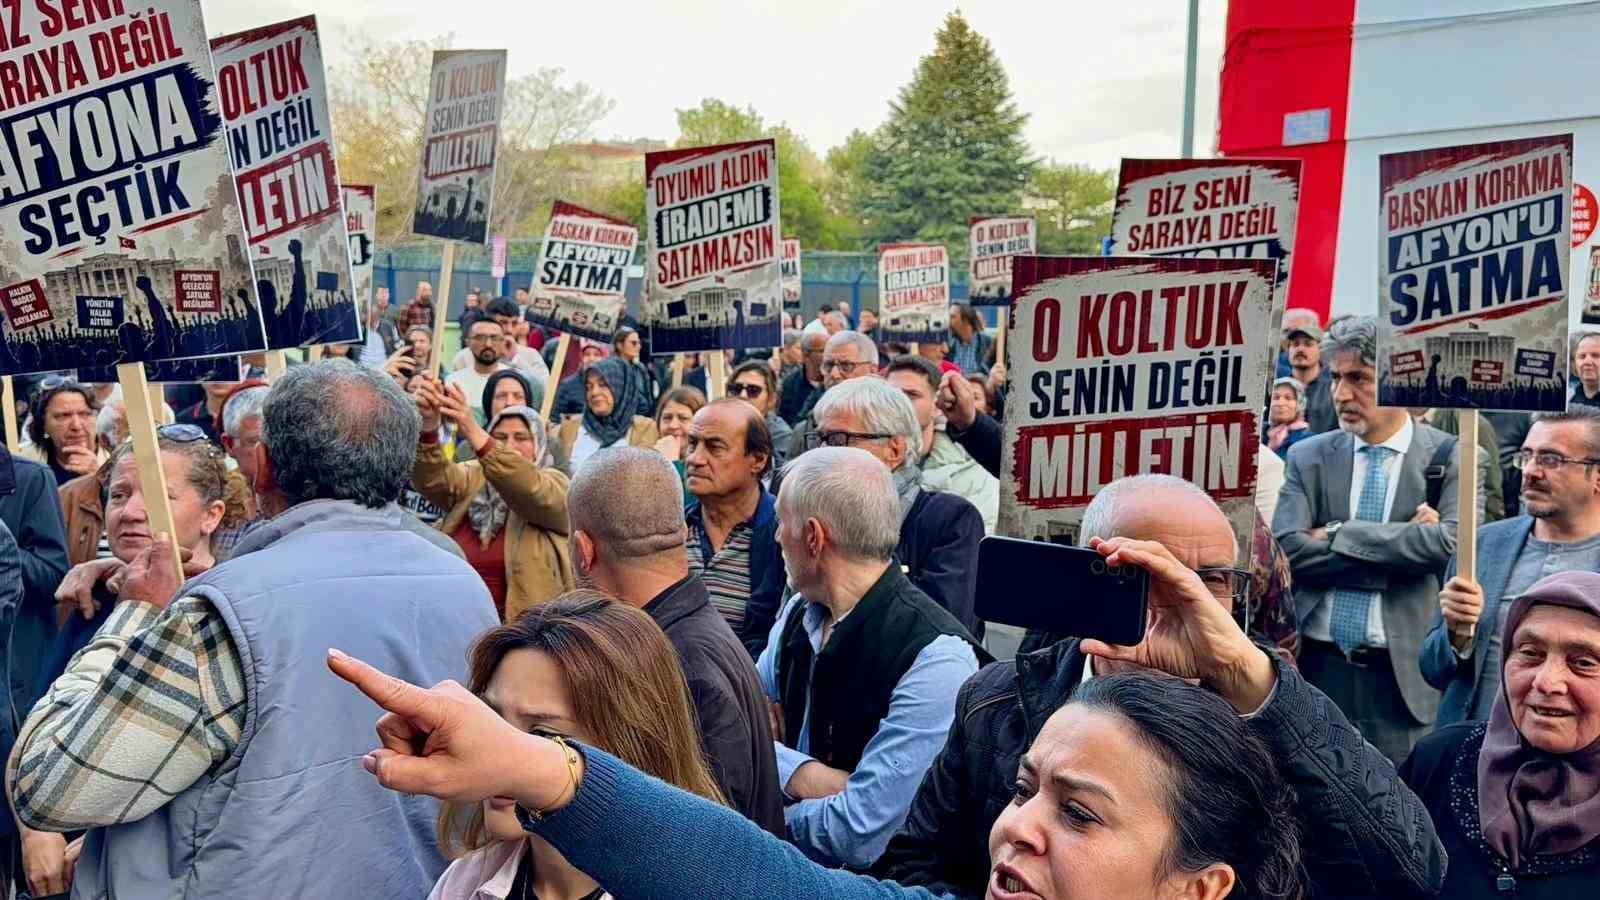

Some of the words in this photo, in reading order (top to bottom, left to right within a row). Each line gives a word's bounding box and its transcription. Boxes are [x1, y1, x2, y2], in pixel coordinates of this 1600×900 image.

[0, 40, 89, 111] RAYA
[89, 7, 183, 80] DEĞİL
[219, 36, 310, 121] OLTUK
[436, 71, 446, 103] O
[448, 62, 497, 99] KOLTUK
[255, 96, 320, 159] DEĞİL
[432, 102, 466, 134] SENİN
[467, 96, 496, 125] DEĞİL
[430, 130, 493, 177] MİLLETİN
[655, 162, 715, 207] OYUMU
[721, 149, 768, 191] ALDIN
[19, 160, 191, 255] SEÇTİK
[242, 152, 330, 238] LETİN
[662, 185, 764, 246] İRADEMİ
[1147, 181, 1187, 217] BİZ
[1193, 170, 1251, 211] SENİ
[1388, 177, 1468, 231] BAŞKAN
[1475, 153, 1563, 209] KORKMA
[550, 221, 592, 241] BAŞKAN
[657, 224, 774, 284] SATAMAZSIN
[977, 228, 984, 242] O
[989, 221, 1029, 240] KOLTUK
[977, 242, 1003, 256] SENİN
[1127, 215, 1212, 251] SARAYA
[1218, 203, 1278, 241] DEĞİL
[1396, 199, 1555, 270] AFYON'U
[540, 261, 623, 291] SATMA
[1390, 238, 1562, 326] SATMA
[1032, 298, 1061, 362] O
[1076, 281, 1248, 359] KOLTUK
[1029, 360, 1136, 420] SENİN
[1147, 350, 1246, 410] DEĞİL
